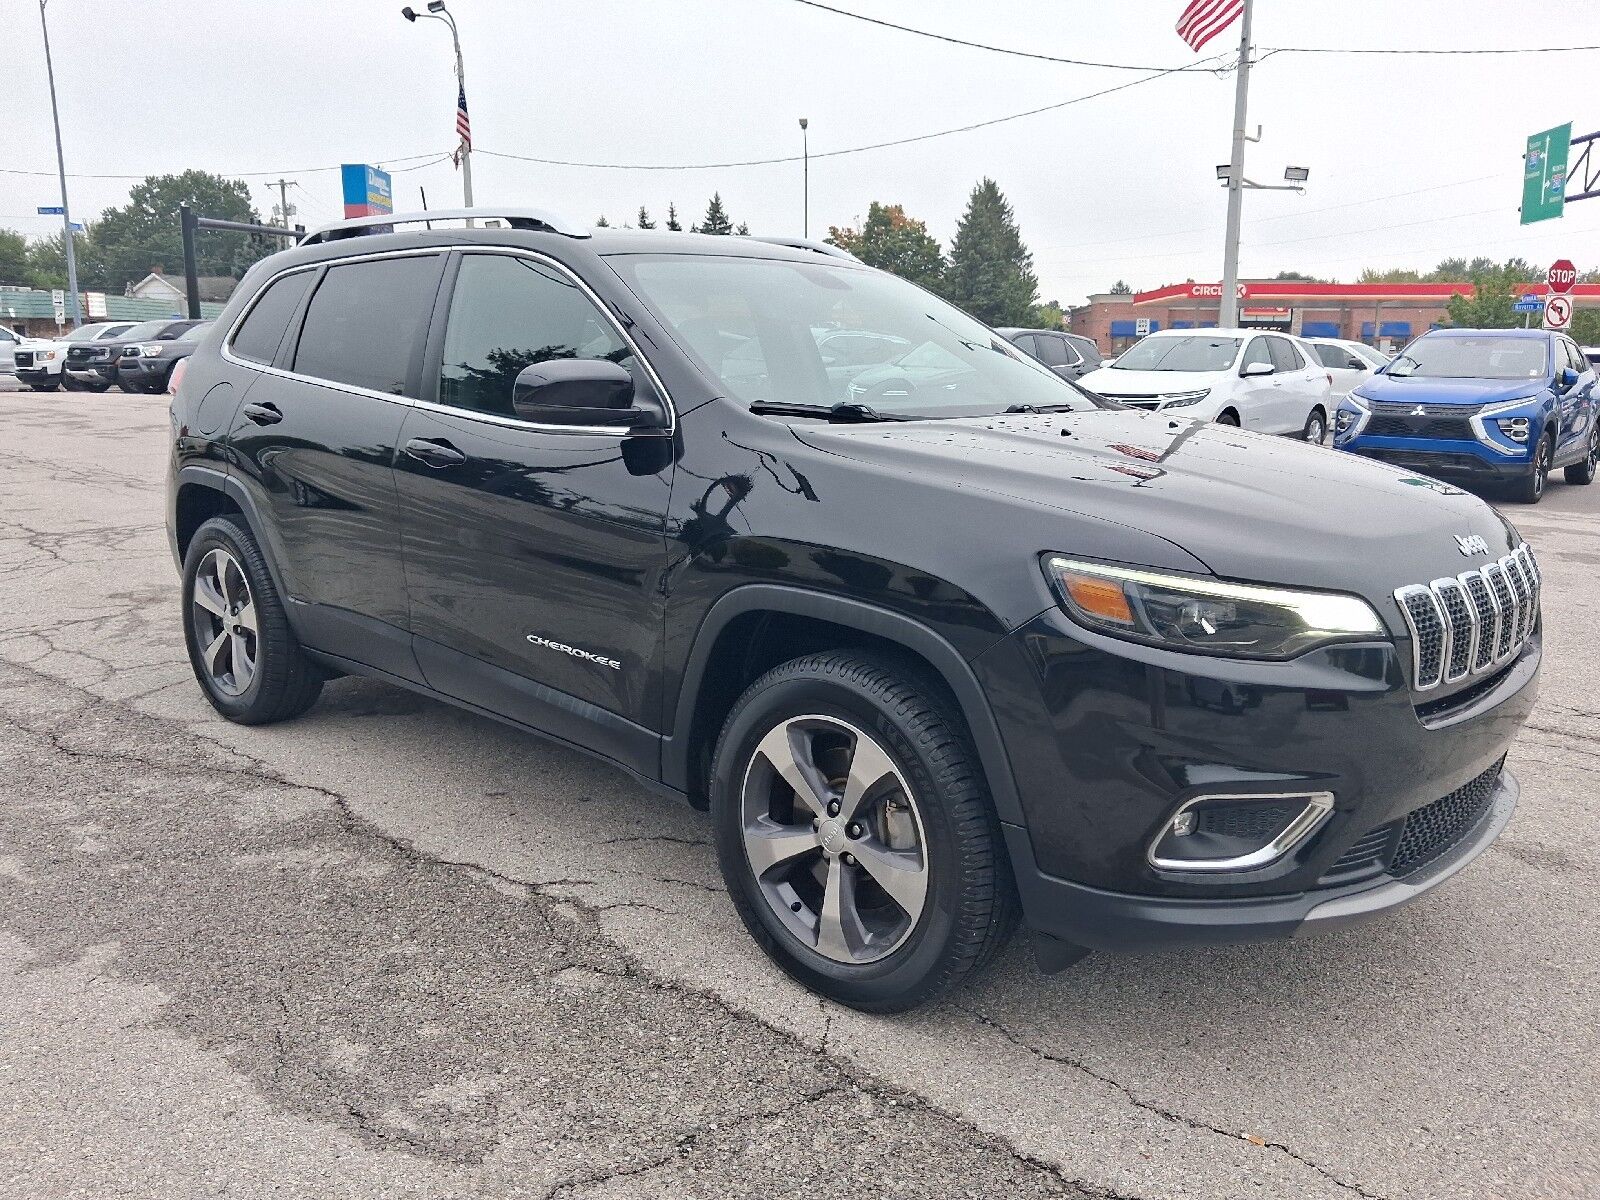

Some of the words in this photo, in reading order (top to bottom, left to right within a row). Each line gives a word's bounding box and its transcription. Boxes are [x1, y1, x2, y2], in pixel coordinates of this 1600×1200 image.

[1549, 269, 1575, 284] STOP
[1191, 285, 1223, 296] CIRCL
[1452, 534, 1490, 558] Jeep
[526, 634, 621, 670] CHEROKEE
